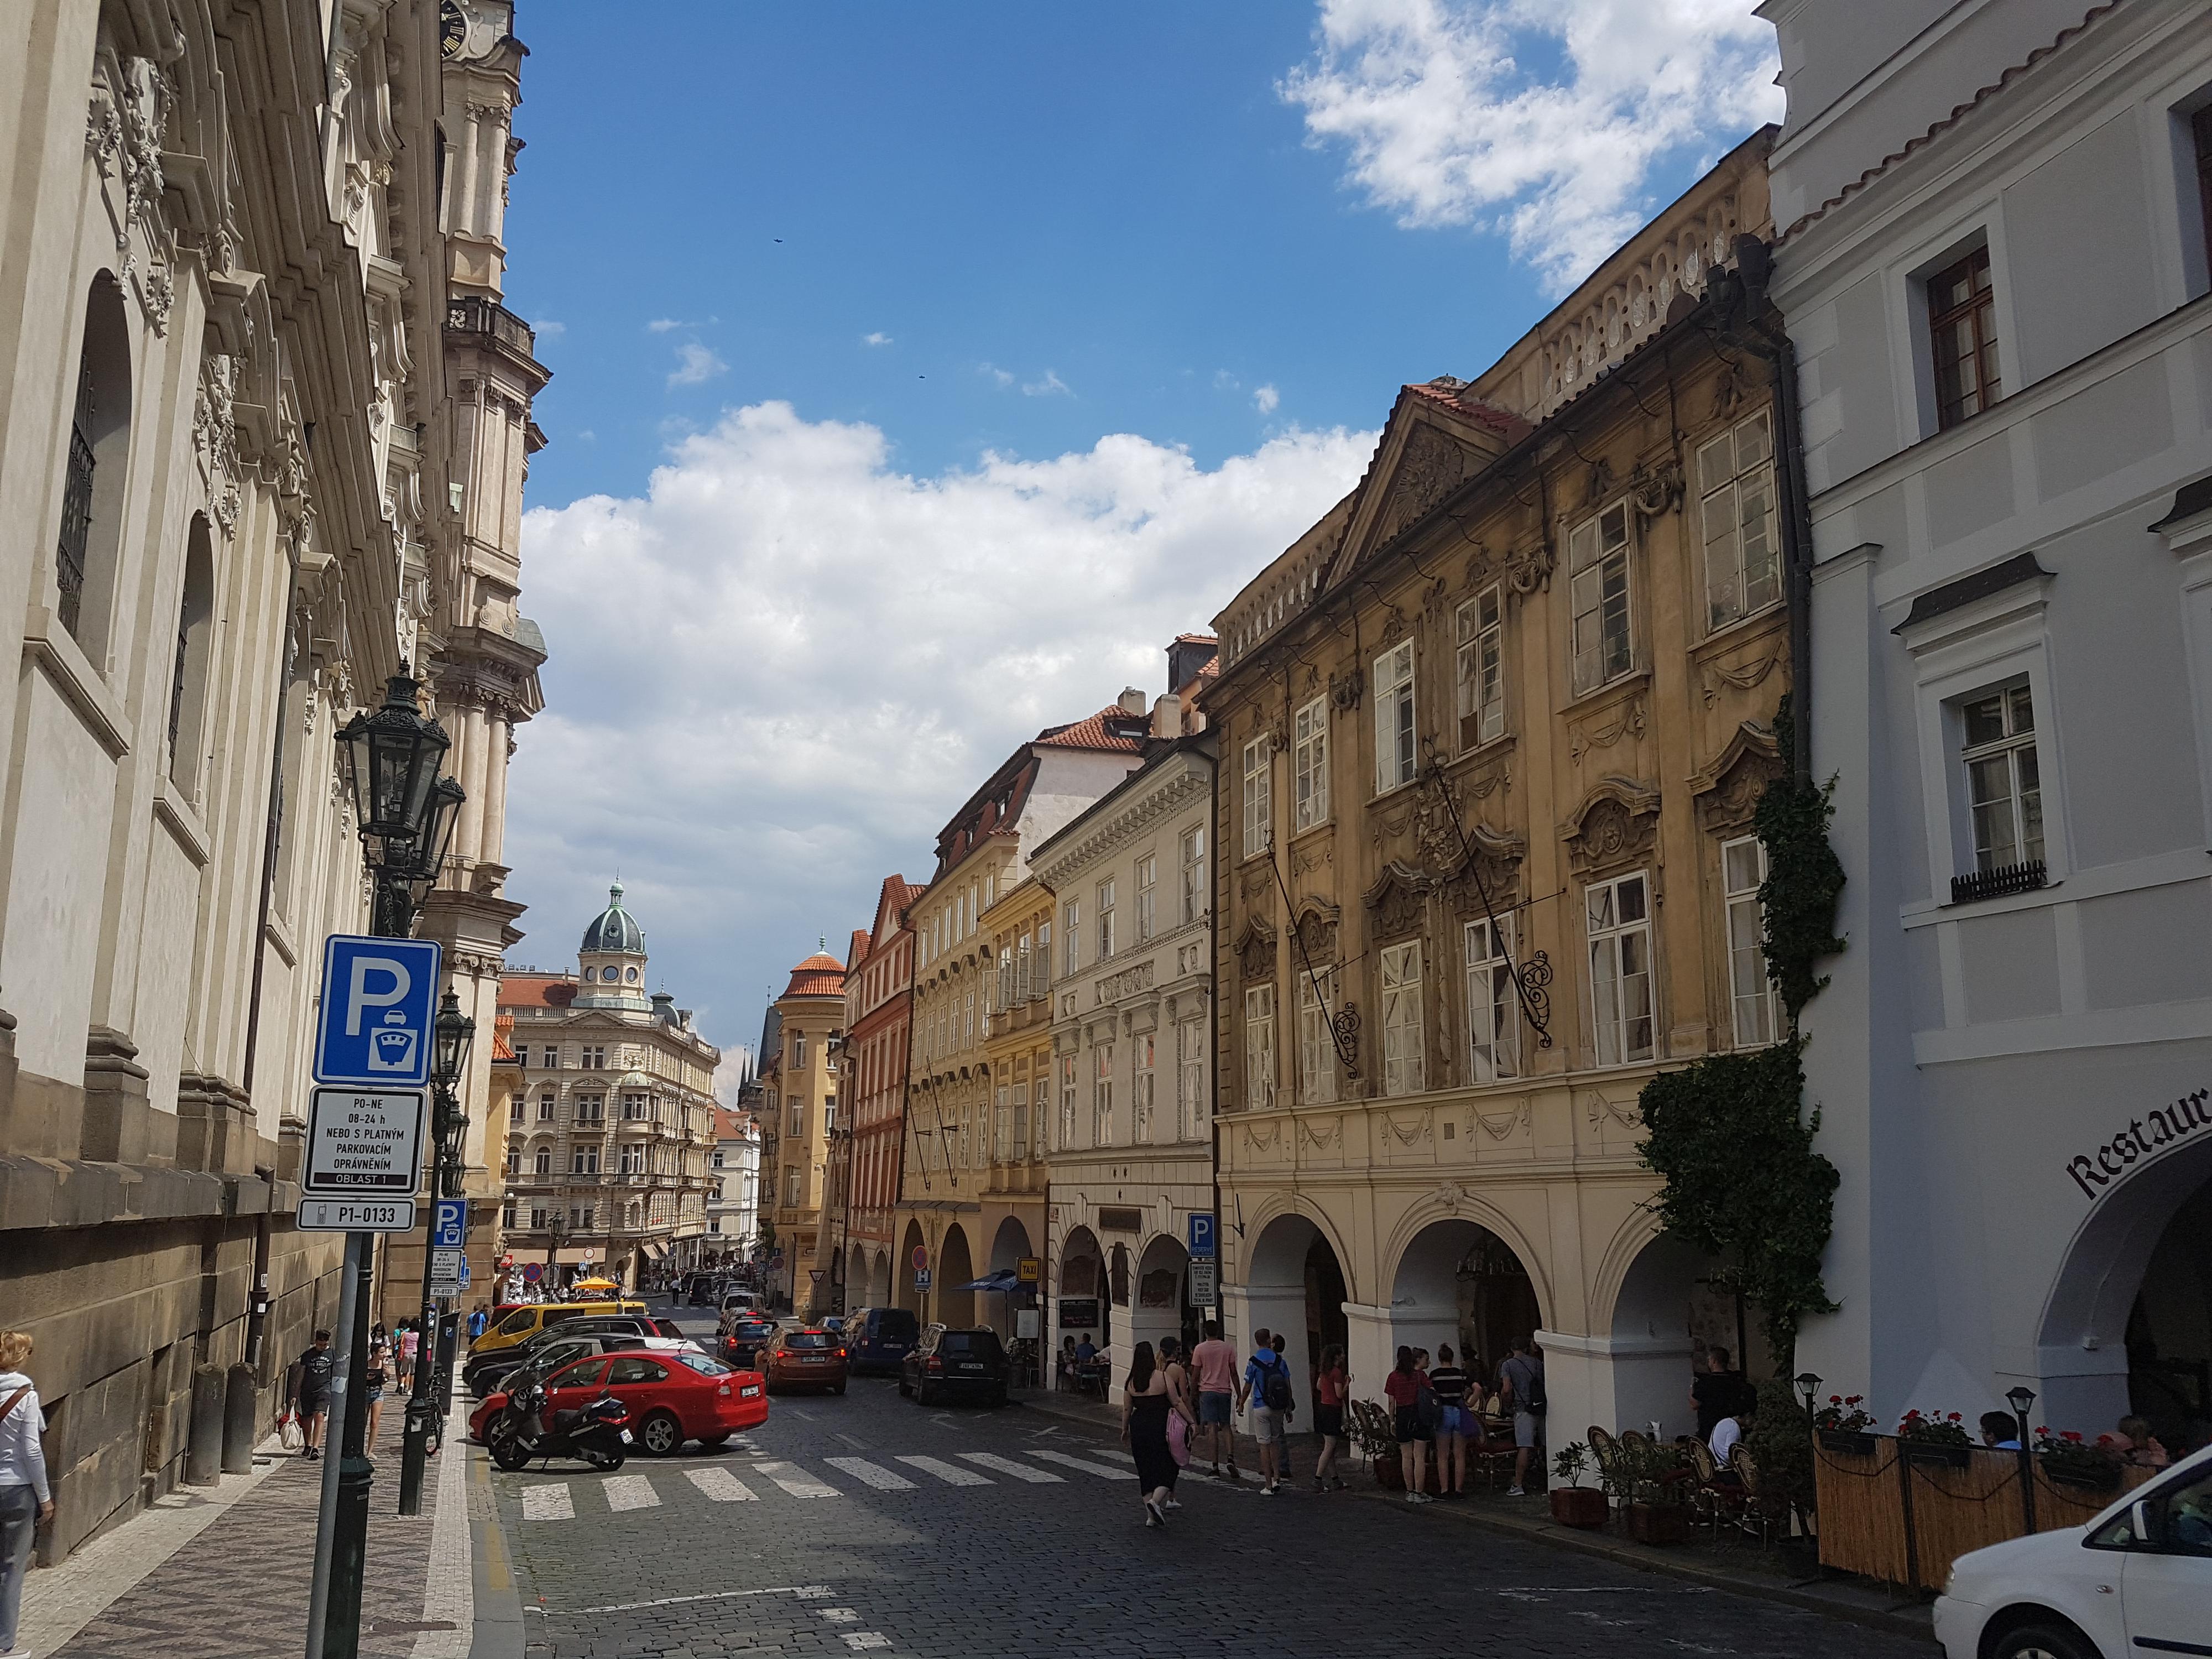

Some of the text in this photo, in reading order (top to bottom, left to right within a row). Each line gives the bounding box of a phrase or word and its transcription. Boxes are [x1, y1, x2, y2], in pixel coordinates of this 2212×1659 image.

[346, 956, 411, 1036] P
[354, 1098, 383, 1109] PO-NE
[348, 1114, 385, 1124] 08-24 h
[326, 1128, 404, 1140] NEBO S PLATNÝM
[336, 1142, 392, 1155] PARKOVACÍM
[334, 1157, 391, 1170] OPRÁVNĚNÍM
[336, 1174, 387, 1184] OBLAST 1
[339, 1207, 395, 1223] P1-0133
[436, 1205, 458, 1233] P
[1194, 1219, 1209, 1244] P
[1023, 1265, 1036, 1274] TAXI
[917, 1270, 928, 1282] H
[445, 1327, 452, 1336] P
